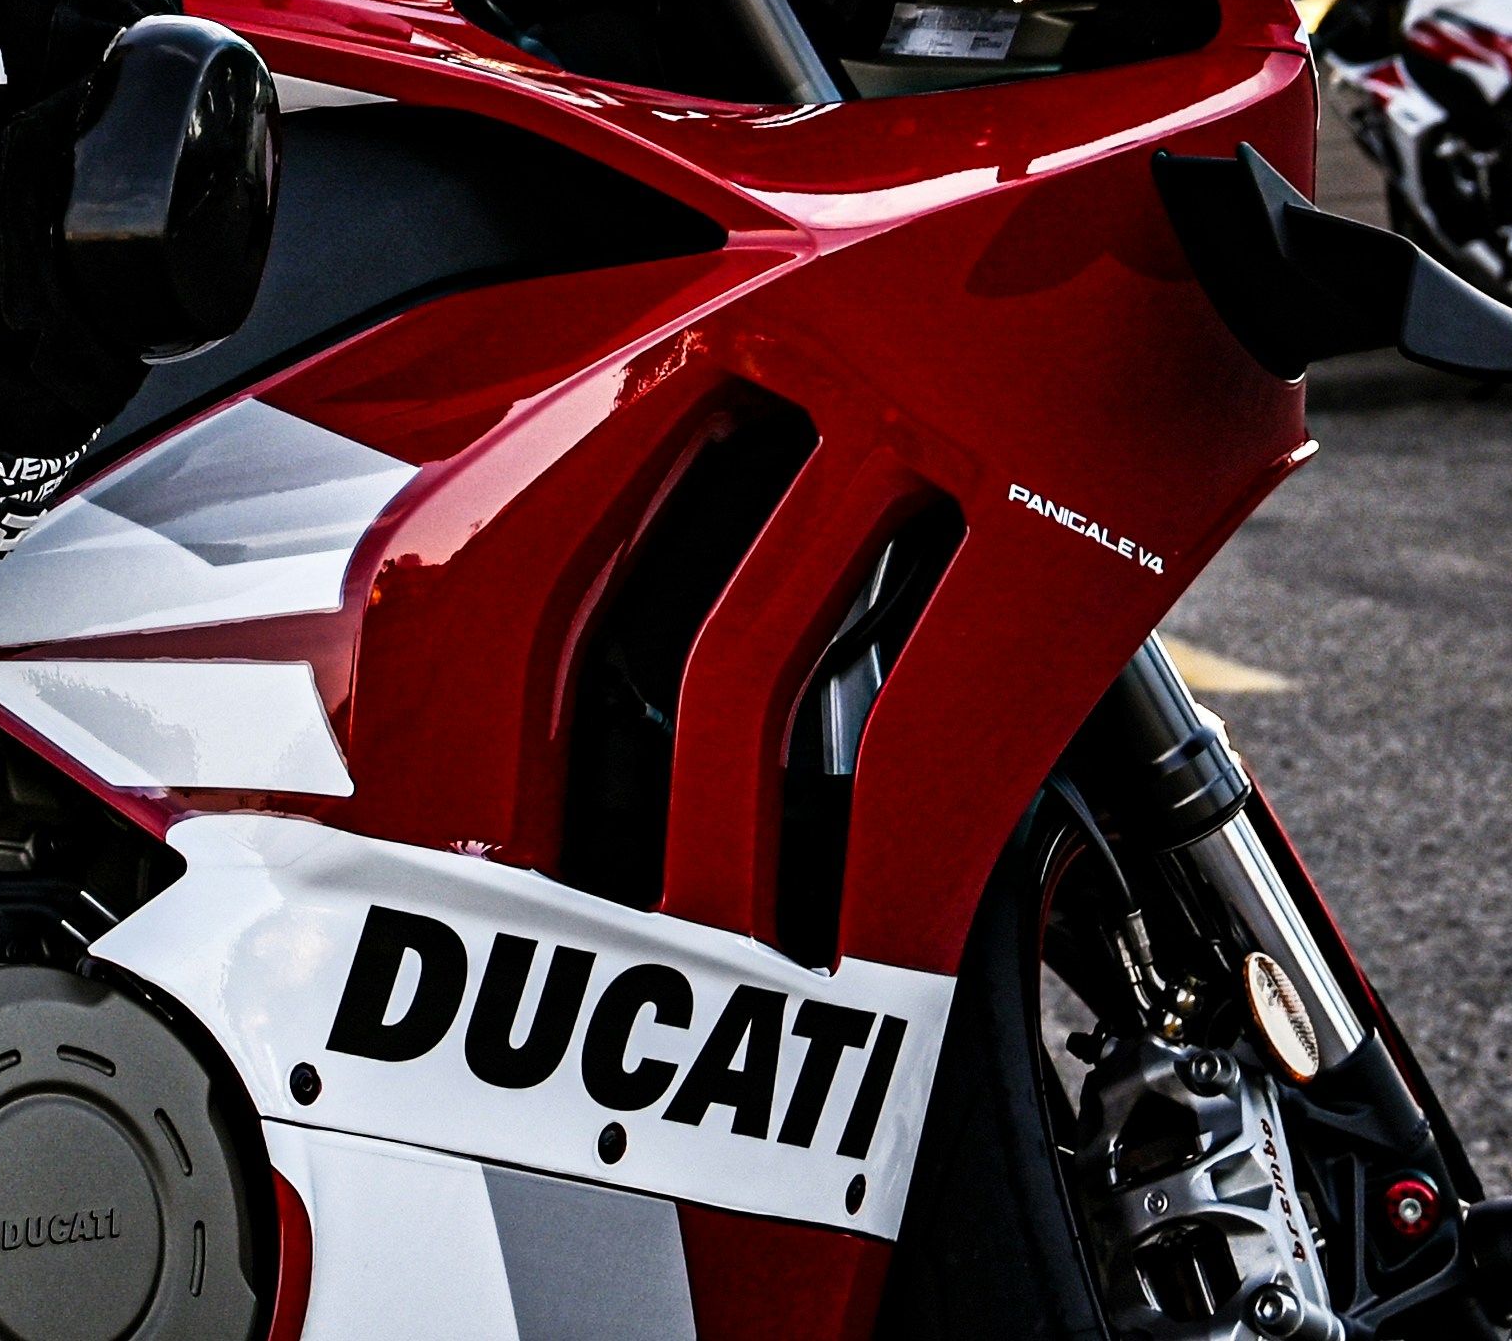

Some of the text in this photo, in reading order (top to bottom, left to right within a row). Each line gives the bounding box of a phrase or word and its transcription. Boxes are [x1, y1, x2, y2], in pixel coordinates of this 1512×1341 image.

[1008, 483, 1164, 575] PANIGALE V4
[325, 904, 910, 1162] DUCATI
[0, 1208, 123, 1253] DUCATI
